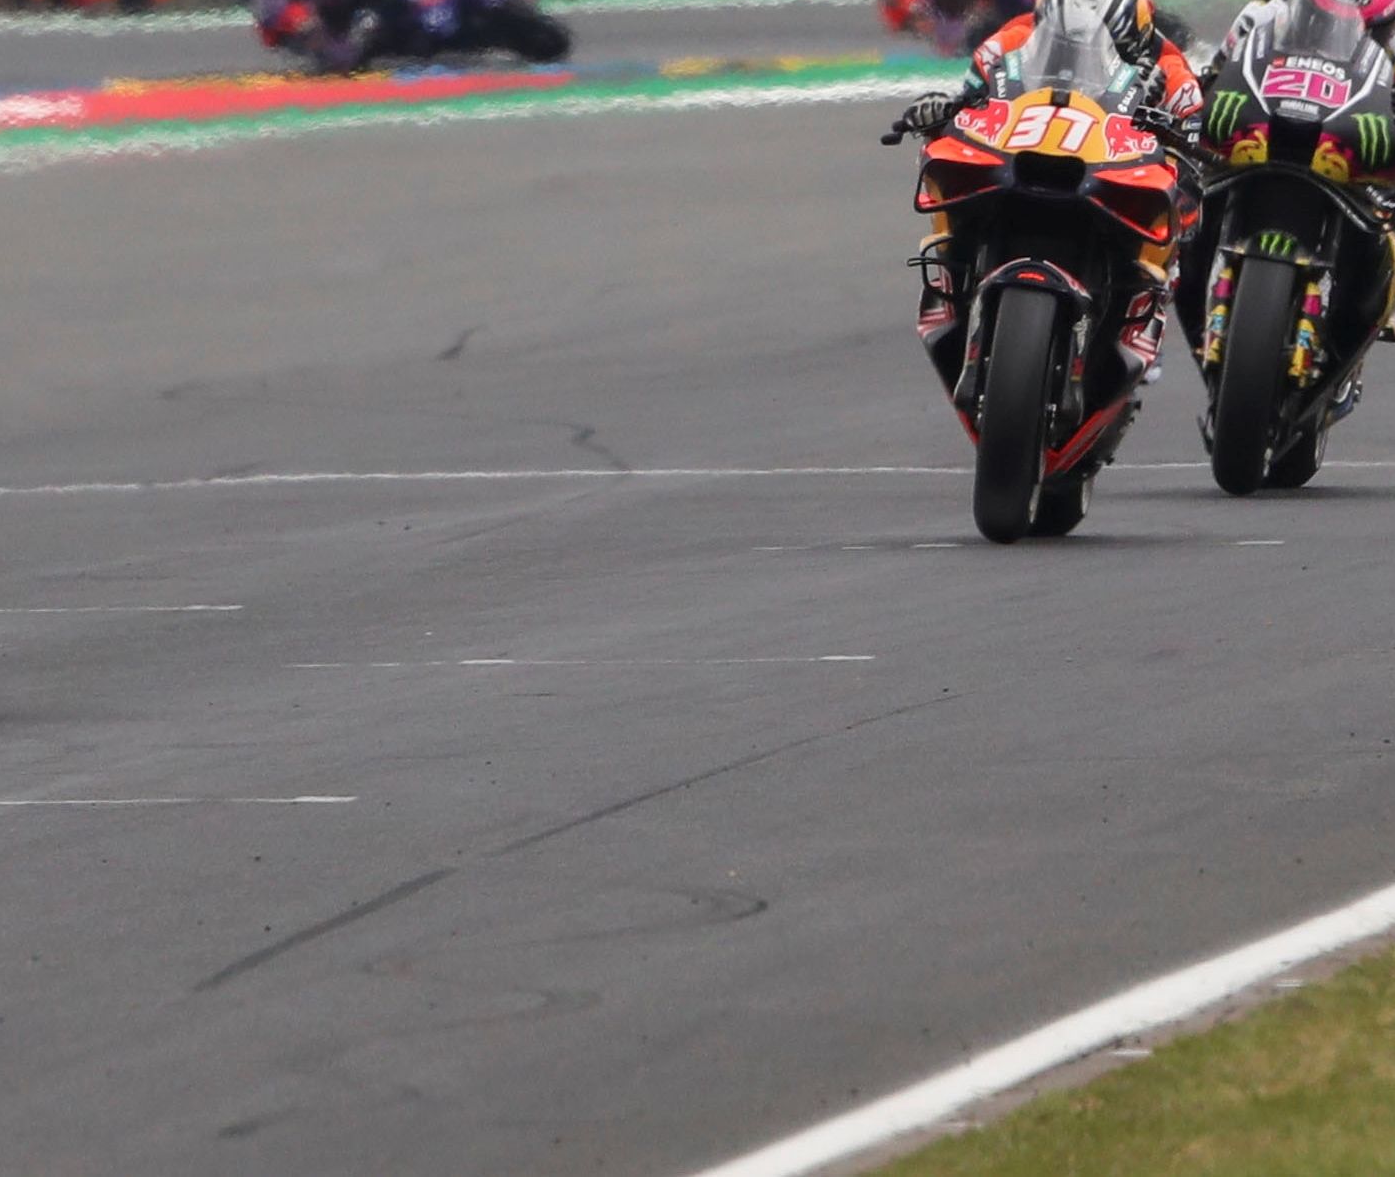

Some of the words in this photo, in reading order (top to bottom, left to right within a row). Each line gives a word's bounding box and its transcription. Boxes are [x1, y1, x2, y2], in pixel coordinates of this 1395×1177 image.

[1261, 65, 1351, 108] 20
[1286, 56, 1346, 81] ENEOS
[1005, 103, 1099, 153] 37
